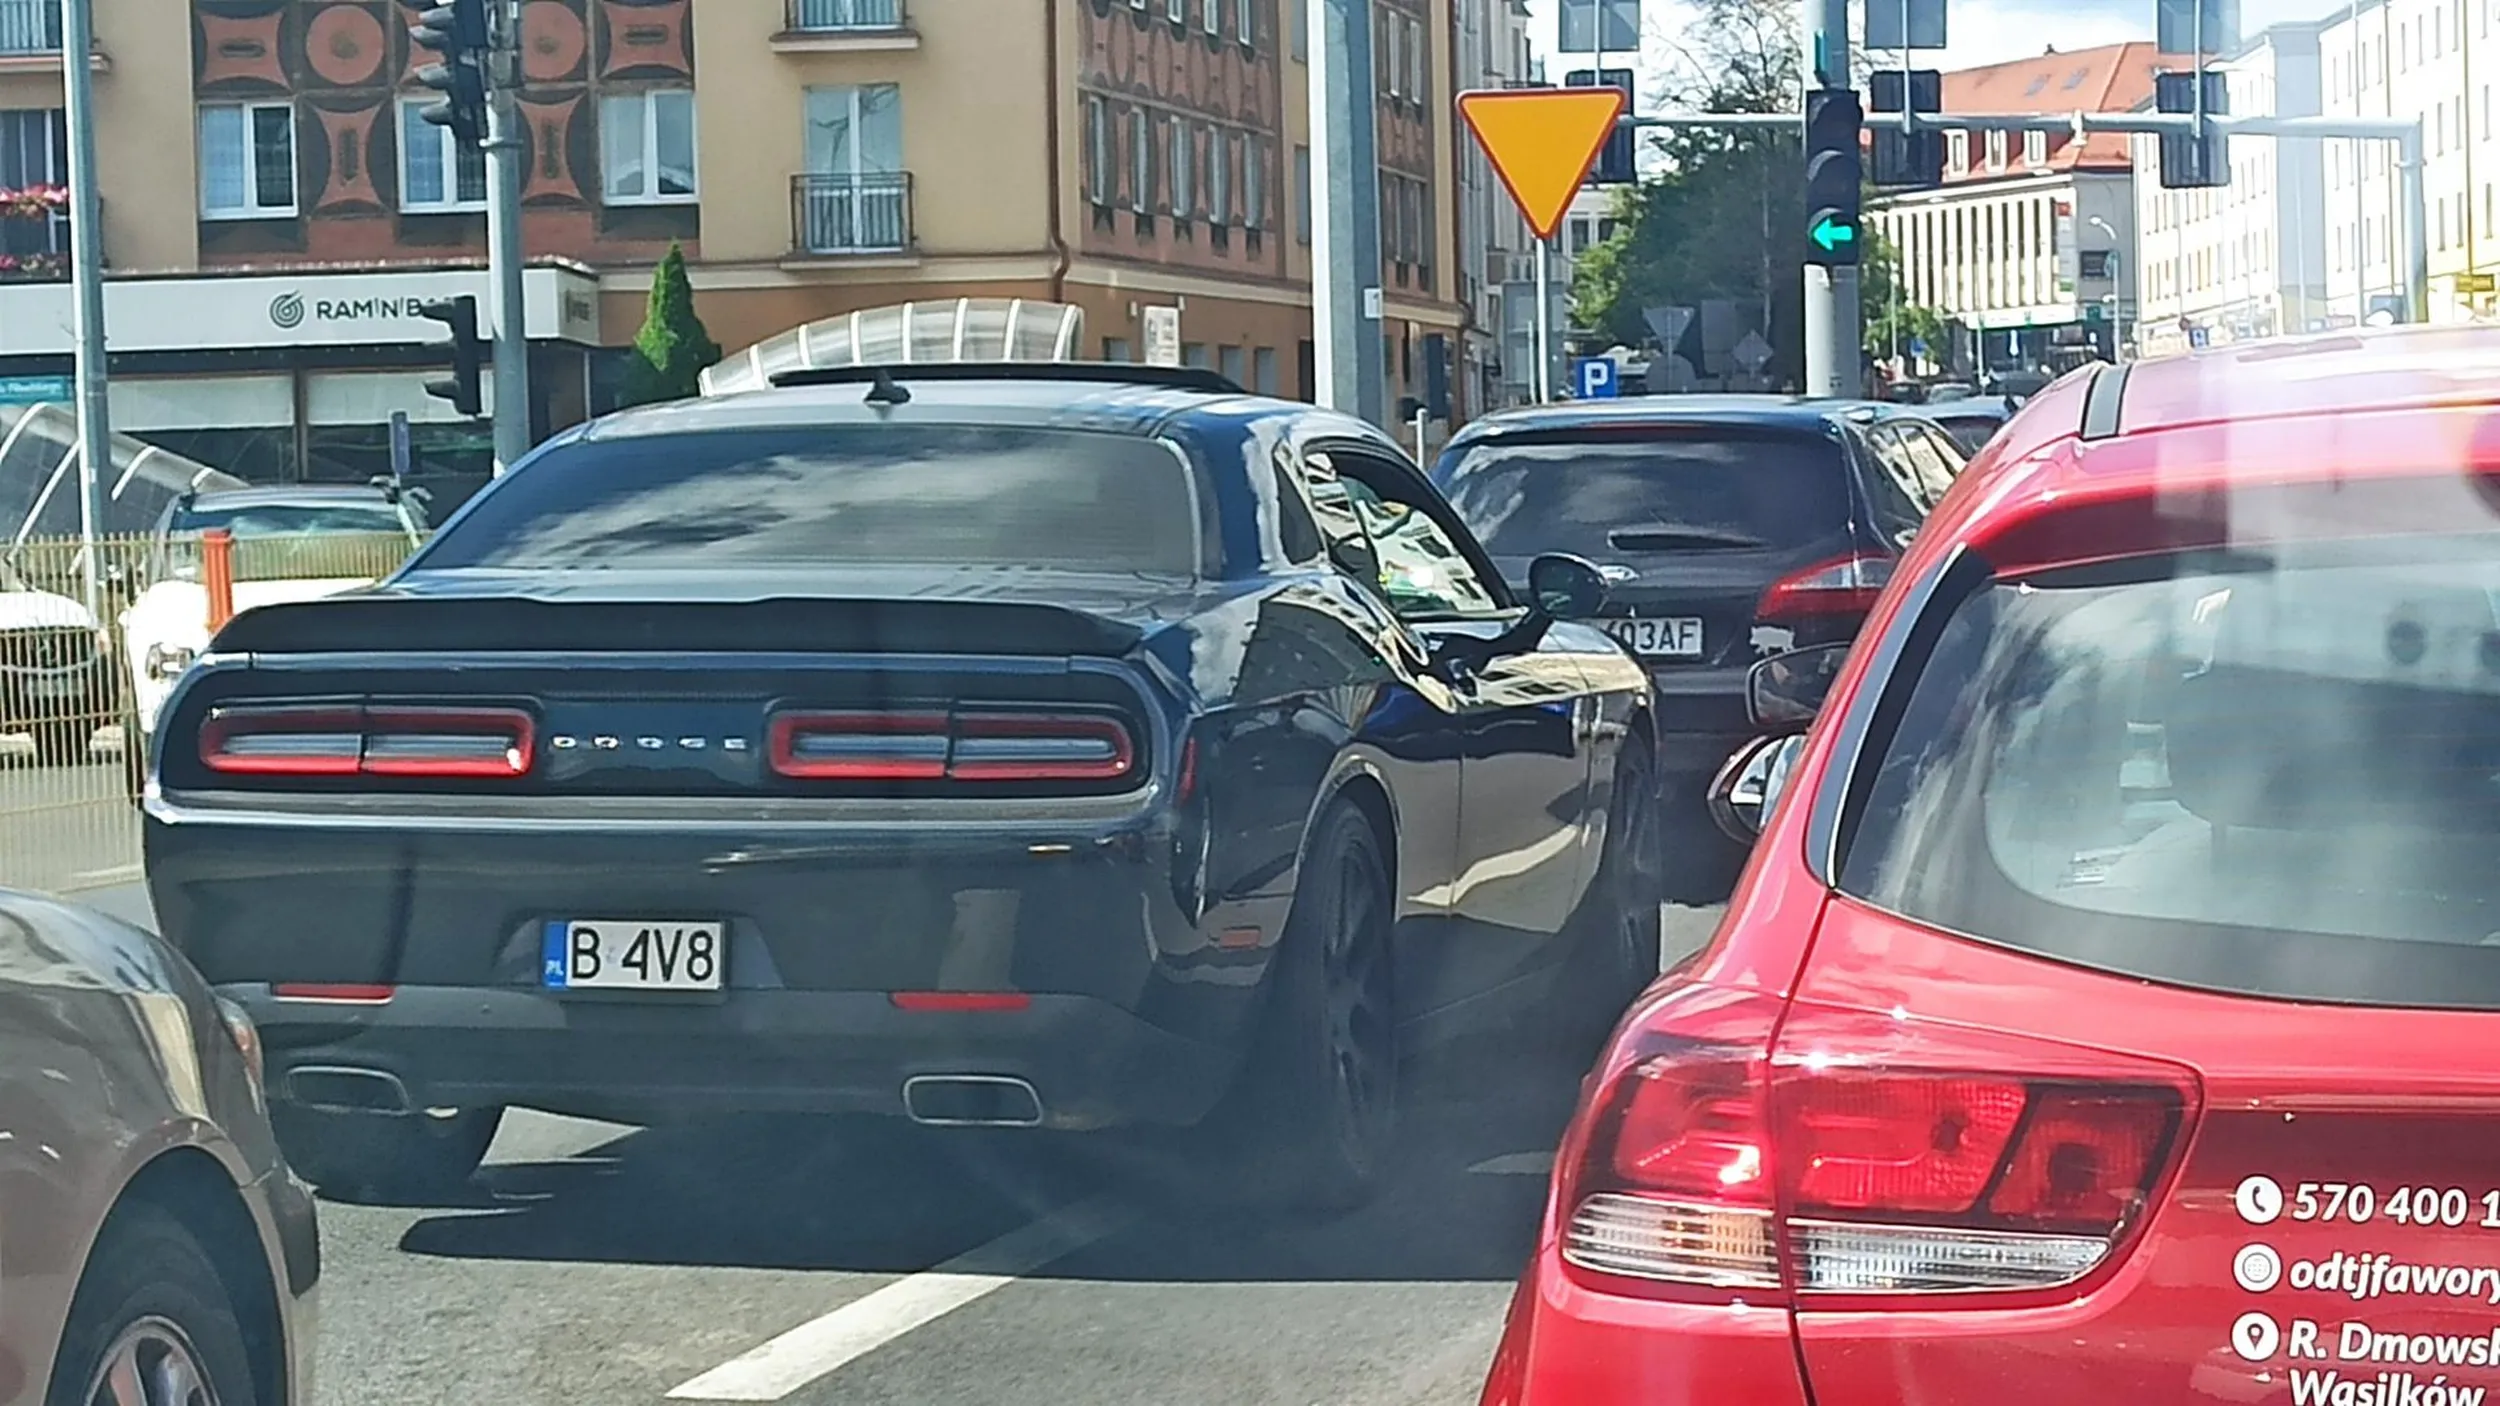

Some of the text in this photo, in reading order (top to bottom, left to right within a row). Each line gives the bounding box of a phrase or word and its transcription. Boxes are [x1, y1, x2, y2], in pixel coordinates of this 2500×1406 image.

[1585, 362, 1608, 396] P
[552, 735, 747, 749] DODGE
[545, 960, 565, 976] PL
[571, 927, 714, 982] B 4V8
[2292, 1183, 2375, 1223] 570
[2384, 1186, 2468, 1227] 400
[2289, 1319, 2328, 1359] R.
